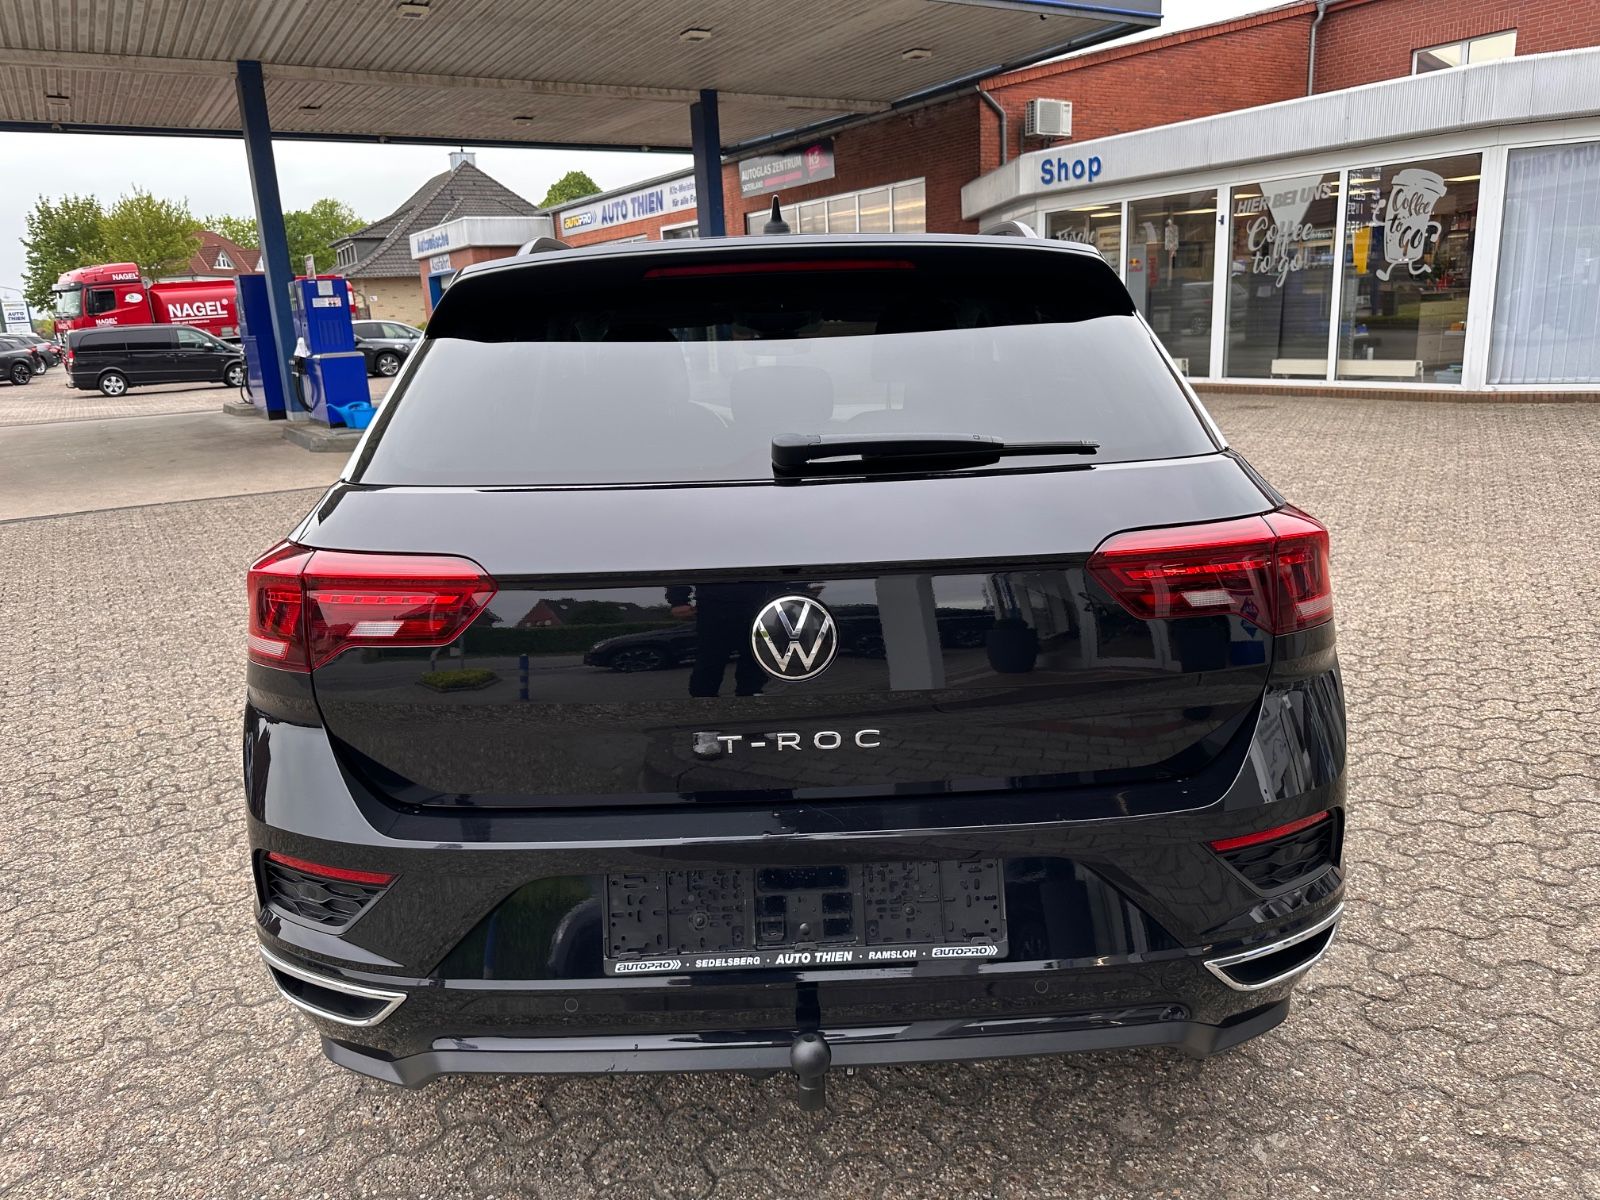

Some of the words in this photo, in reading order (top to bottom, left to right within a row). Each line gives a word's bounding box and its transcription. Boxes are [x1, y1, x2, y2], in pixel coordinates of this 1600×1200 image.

[742, 163, 772, 181] AUTOGLAS
[772, 155, 803, 173] ZENTRUM
[1041, 156, 1102, 184] Shop
[601, 199, 628, 225] AUTO
[630, 189, 664, 218] THIEN
[1237, 196, 1271, 213] HIER
[1271, 190, 1298, 208] BEI
[1300, 183, 1331, 204] UNS
[1392, 188, 1431, 217] Coffee
[1246, 216, 1313, 258] Coffee
[1251, 251, 1271, 274] to
[112, 272, 139, 281] NAGEL
[168, 301, 228, 318] NAGEL
[757, 599, 833, 674] VW
[717, 729, 881, 754] T-ROC
[695, 957, 761, 968] SEDELSBERG
[775, 953, 811, 965] AUTO
[815, 951, 853, 963] THIEN
[868, 950, 917, 960] RAMSLOH
